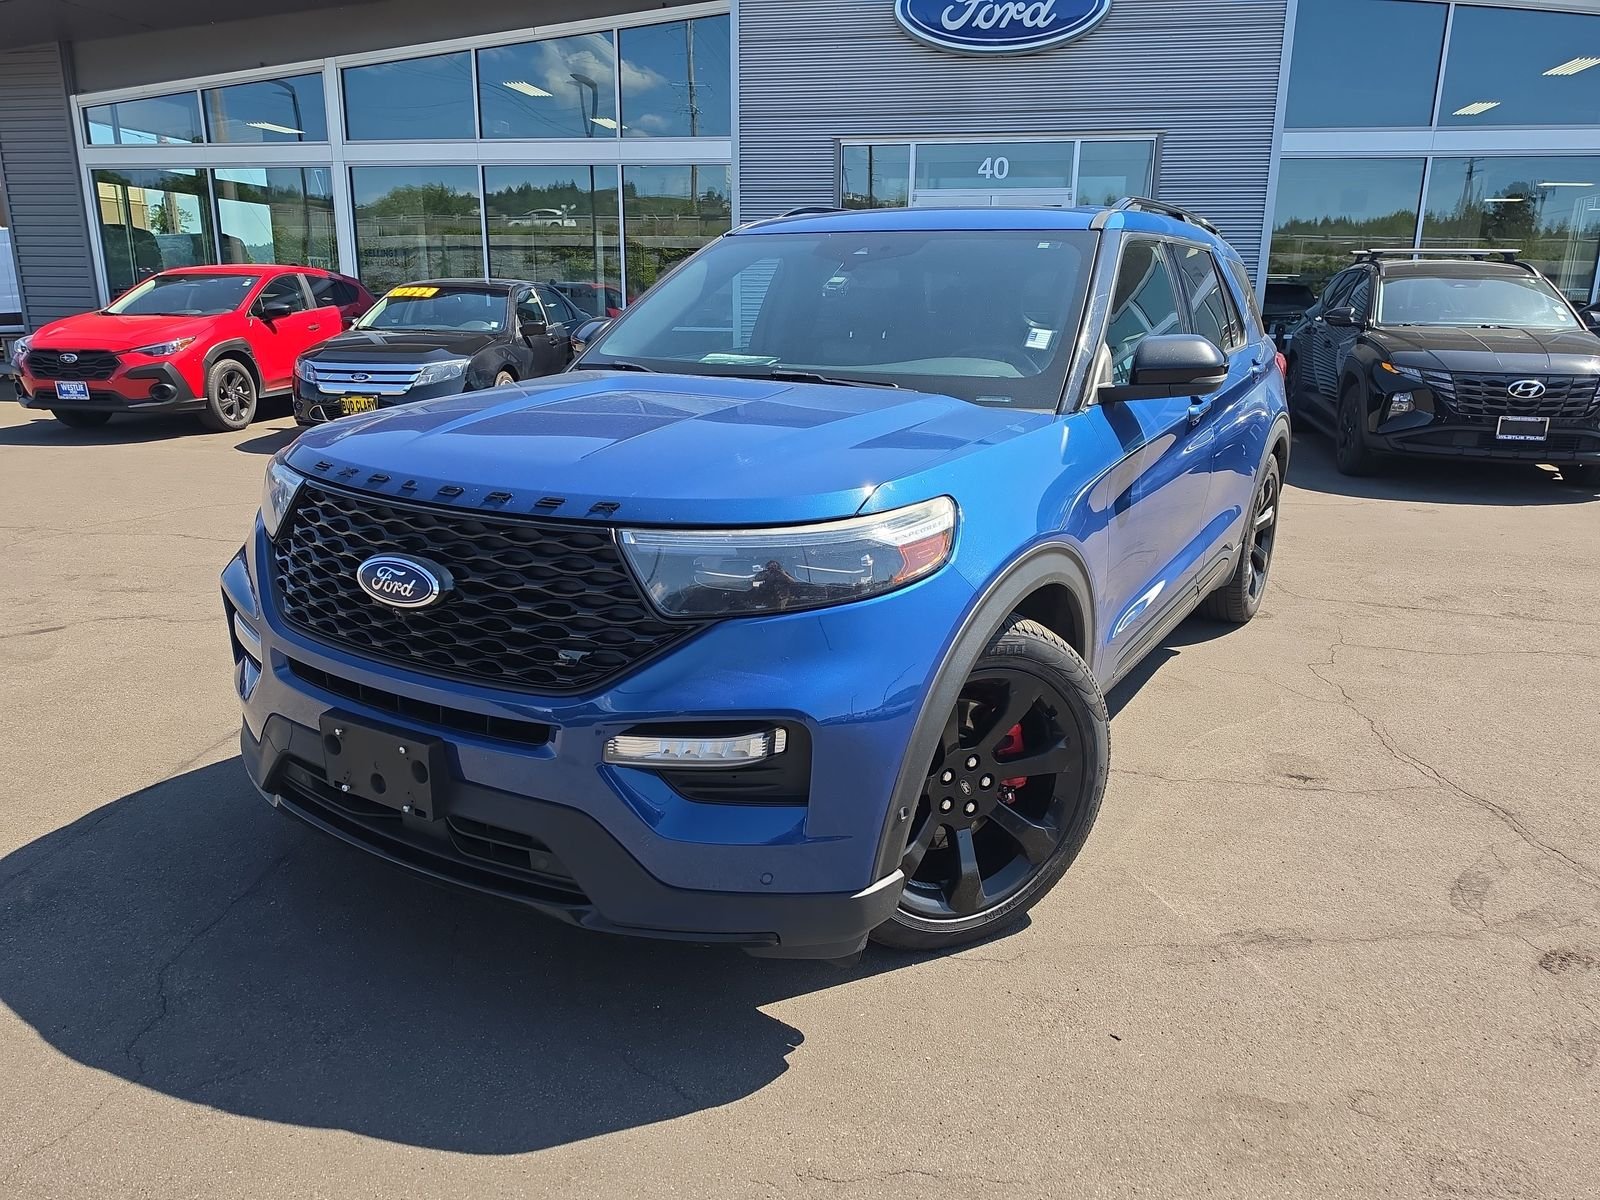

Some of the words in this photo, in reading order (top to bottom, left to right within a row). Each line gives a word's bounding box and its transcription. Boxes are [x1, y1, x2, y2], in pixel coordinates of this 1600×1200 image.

[977, 156, 1009, 179] 40
[314, 460, 621, 514] EXPLORER
[371, 566, 417, 597] Ford
